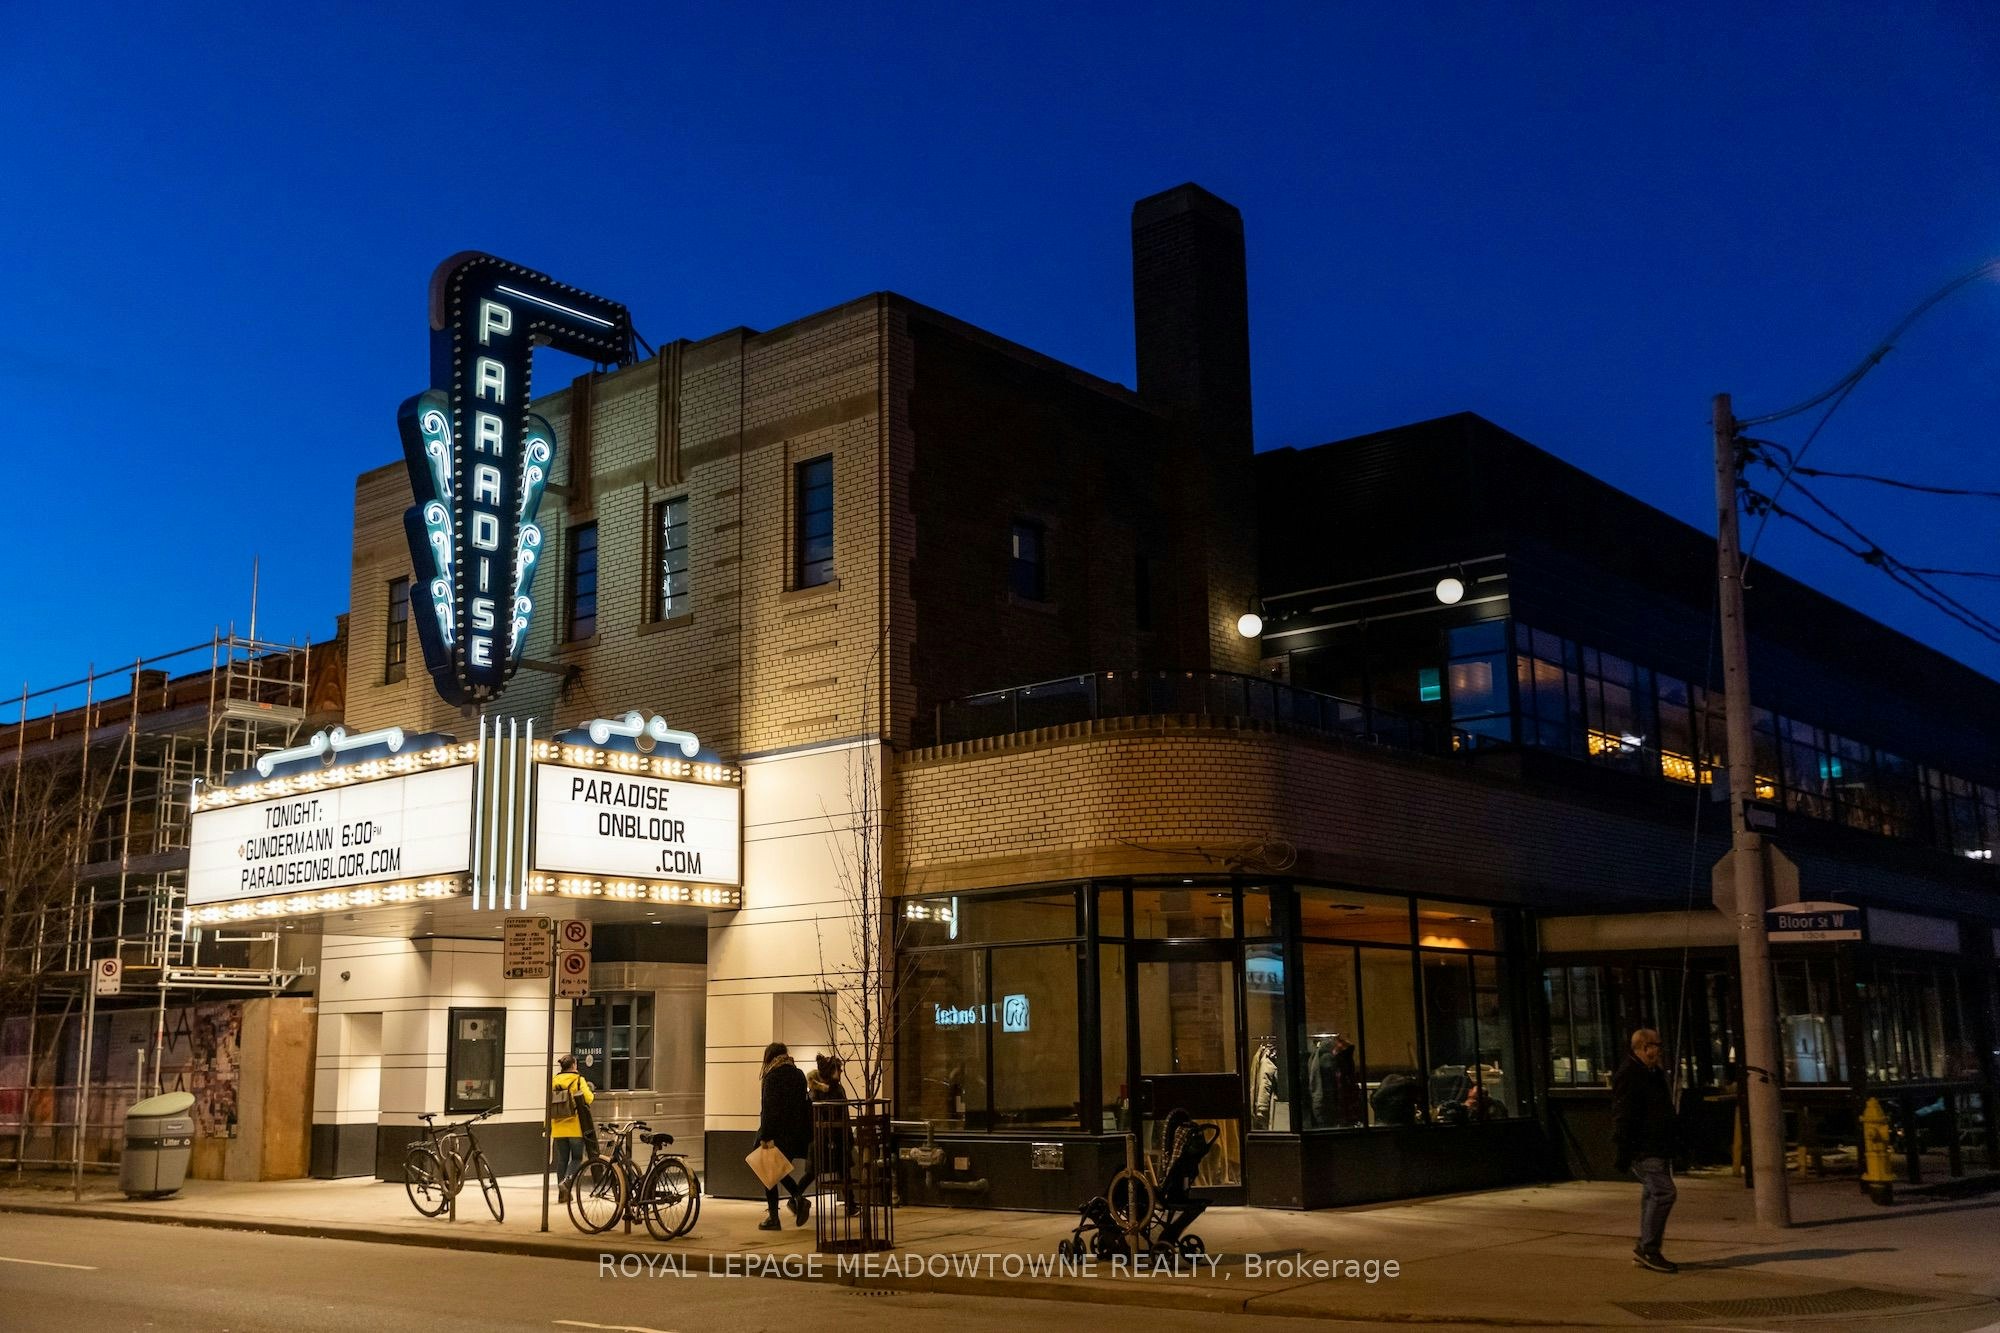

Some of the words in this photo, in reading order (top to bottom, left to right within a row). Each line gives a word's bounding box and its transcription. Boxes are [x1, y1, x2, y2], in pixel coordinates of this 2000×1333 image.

[472, 298, 513, 668] PARADISE
[571, 777, 670, 811] PARADISE
[265, 799, 323, 830] TONIGHT:
[598, 812, 685, 843] ONBLOOR
[246, 826, 334, 861] GUNDERMANN
[341, 821, 373, 847] 6:00
[241, 846, 401, 890] PARADISEONBLOOR.COM
[656, 849, 702, 875] .COM
[1779, 915, 1814, 929] Bloor
[1817, 916, 1829, 928] St
[1833, 914, 1844, 928] W
[163, 1137, 180, 1147] Litter
